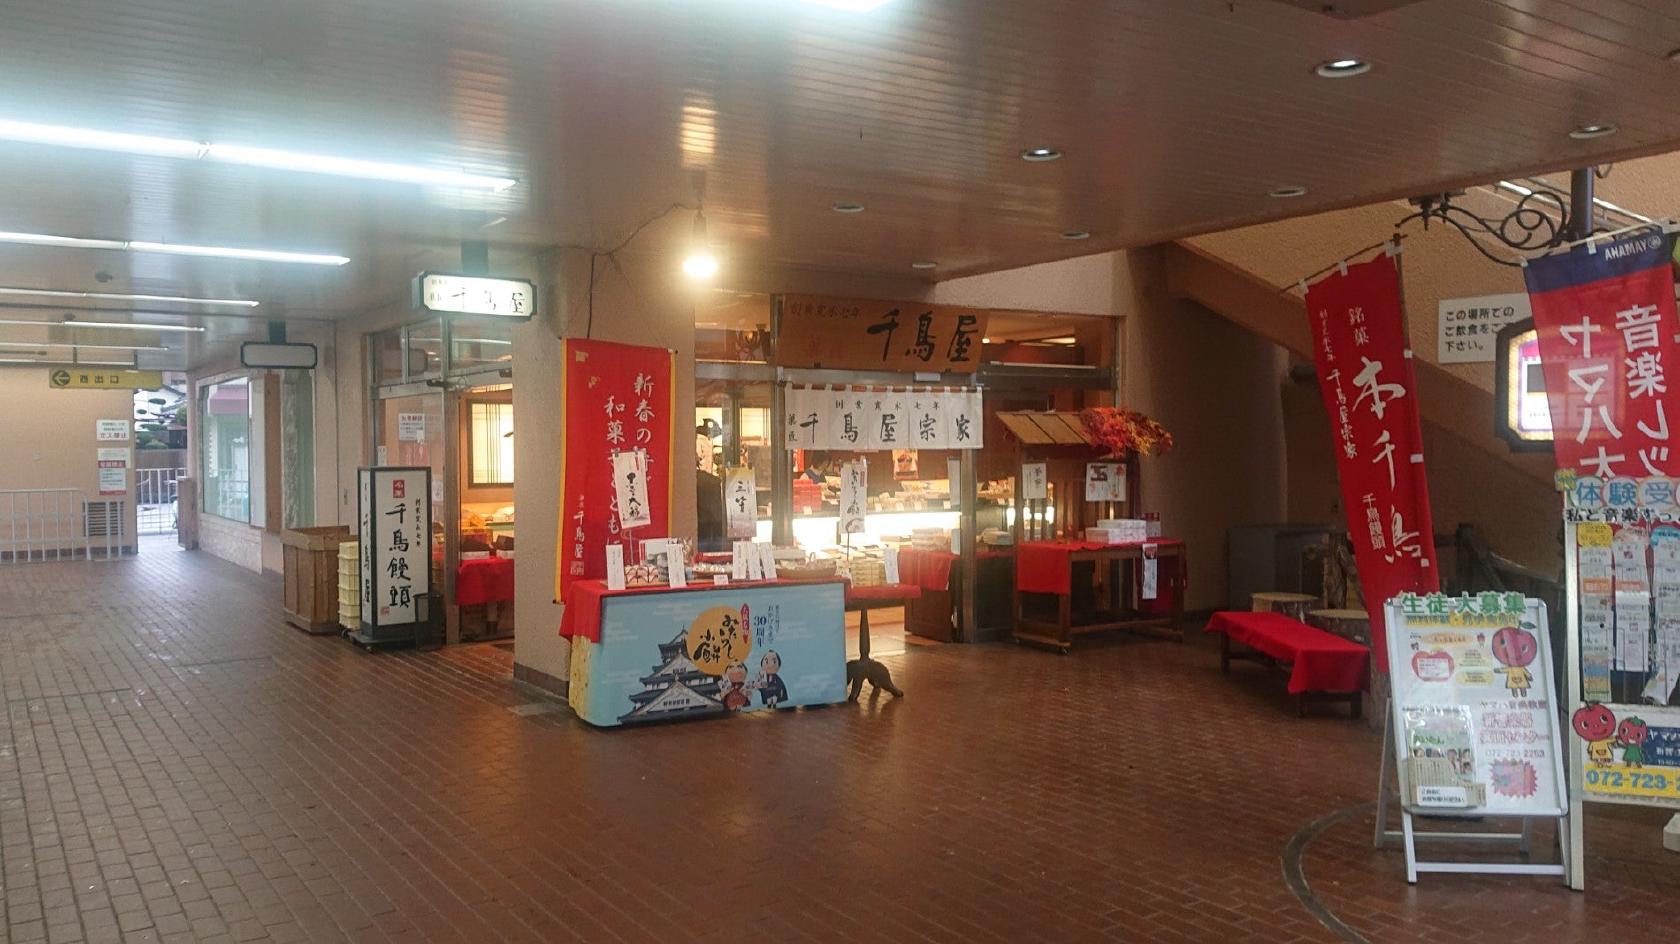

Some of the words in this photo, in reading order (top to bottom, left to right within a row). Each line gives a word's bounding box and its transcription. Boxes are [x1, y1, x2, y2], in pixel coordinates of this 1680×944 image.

[1446, 306, 1515, 322] この場所での
[866, 308, 979, 363] 千鳥屋
[1445, 341, 1484, 352] 下さい。
[79, 374, 119, 384] 西出口
[800, 412, 970, 444] 千鳥屋宗家
[1352, 356, 1422, 564] 本千鳥
[1576, 482, 1673, 505] 体験受
[1565, 507, 1680, 522] 私と音楽ずっ
[385, 502, 411, 609] 千鳥饅頭
[1401, 592, 1527, 614] 生徒大募集
[1585, 768, 1680, 793] 072-723-
